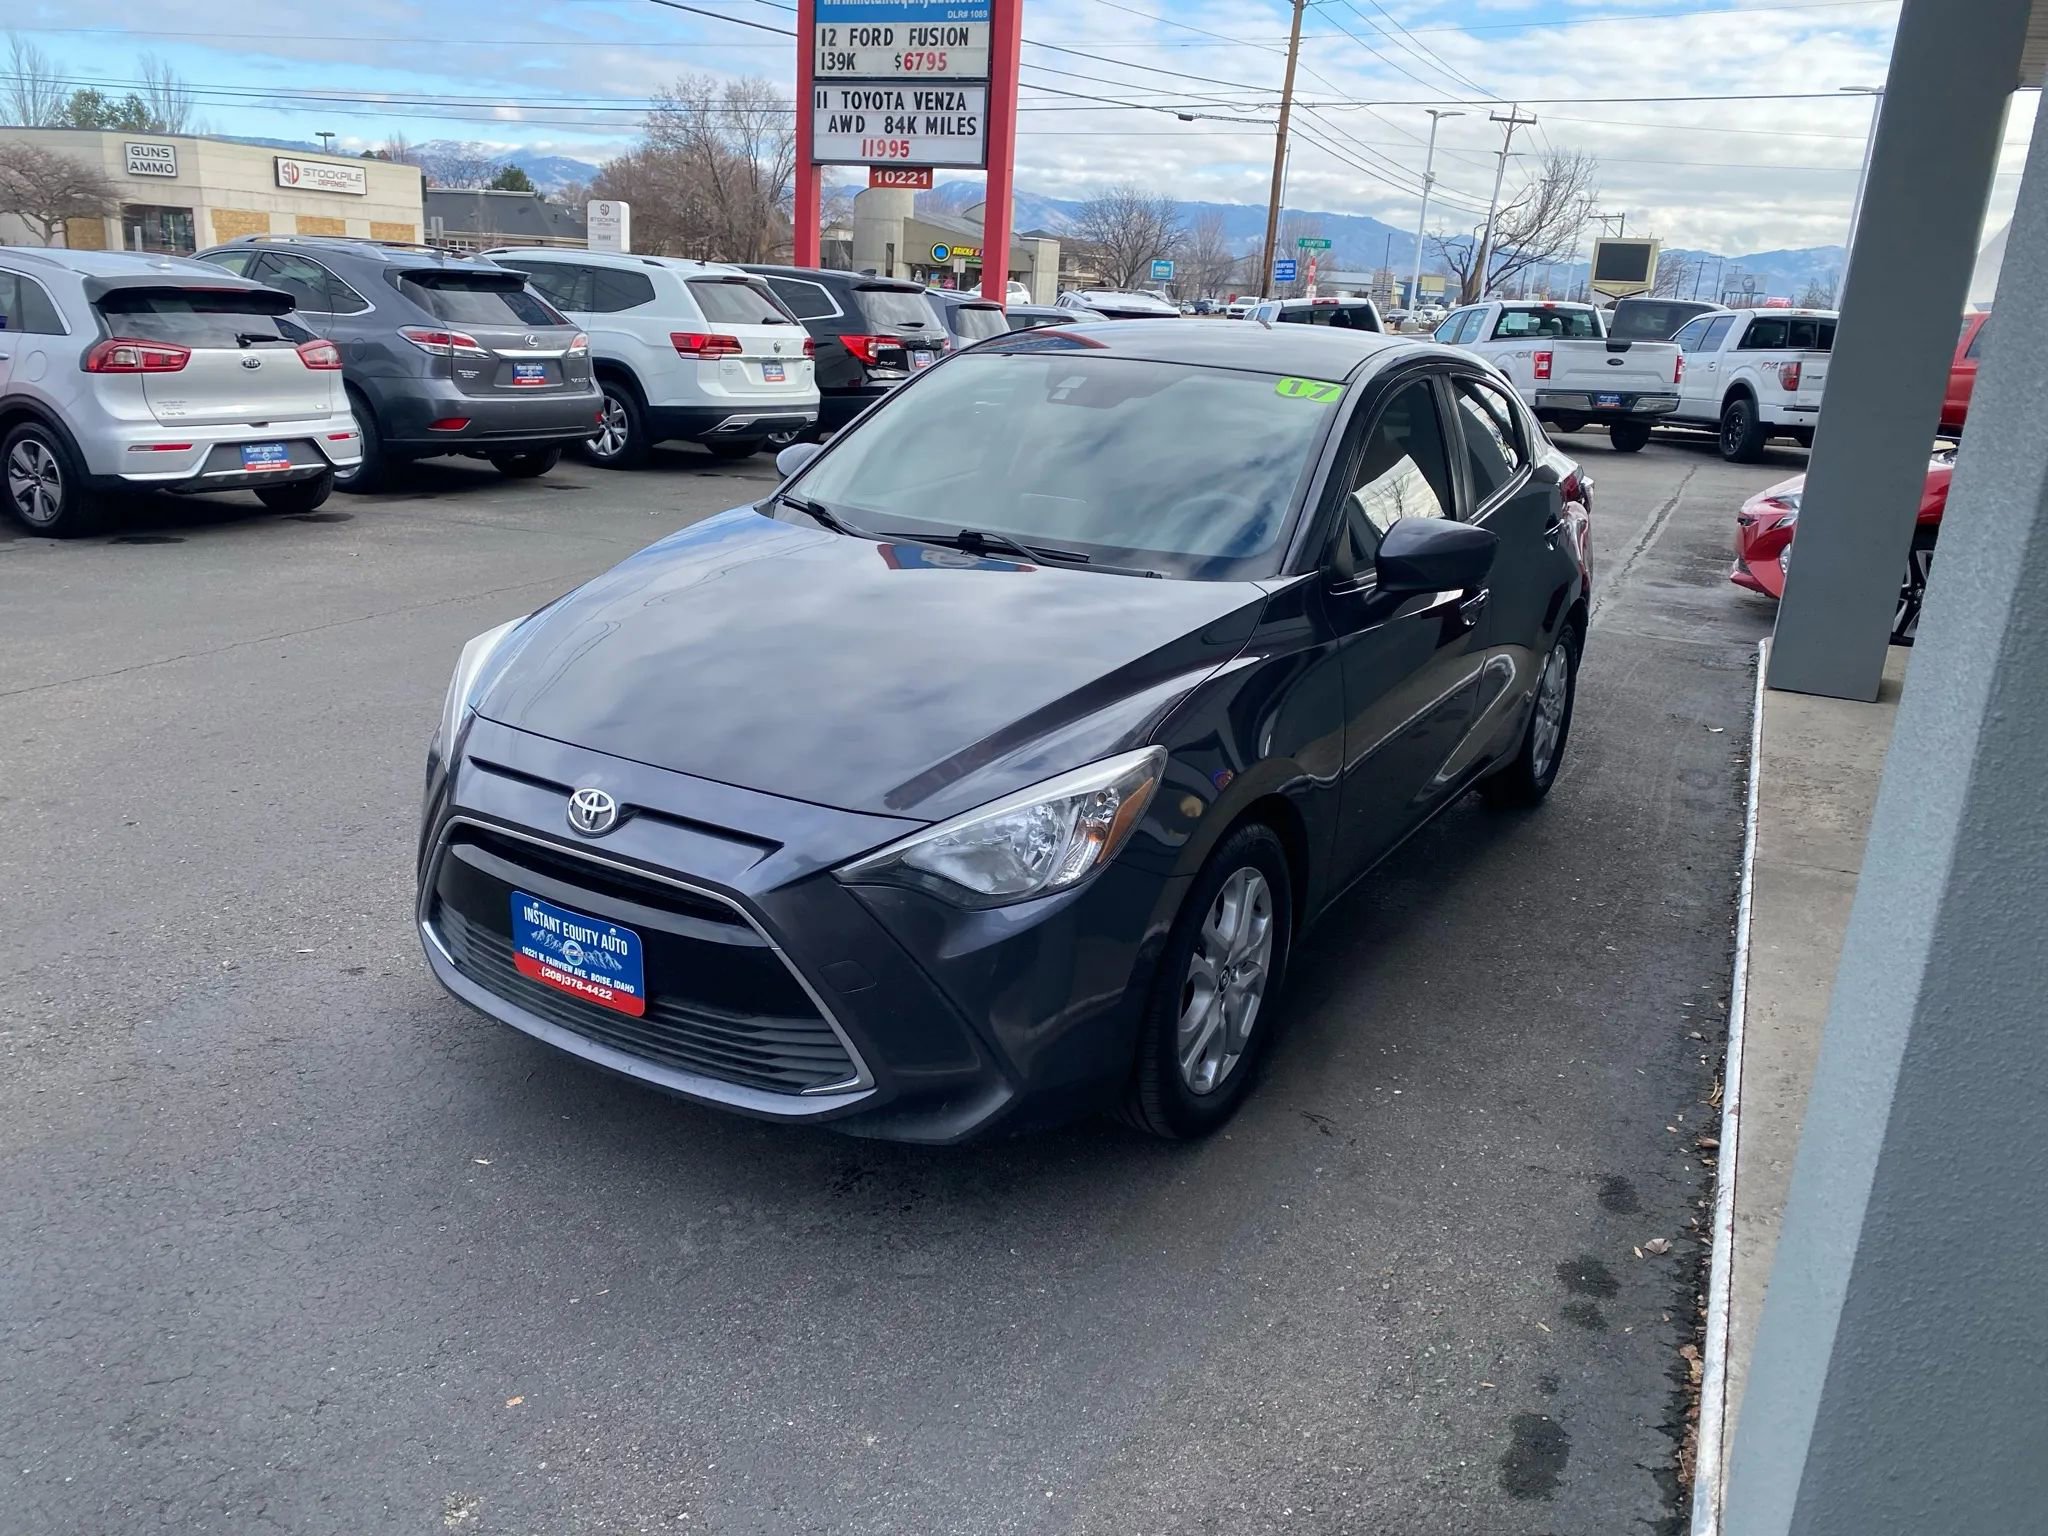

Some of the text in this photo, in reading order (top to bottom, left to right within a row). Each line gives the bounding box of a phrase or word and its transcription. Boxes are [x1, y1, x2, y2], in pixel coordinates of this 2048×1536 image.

[821, 27, 969, 47] 12 FORD FUSION
[821, 52, 948, 71] 139K $6795
[816, 91, 967, 111] 11 TOYOTA VENZA
[828, 115, 977, 135] AWD 84K MILES
[130, 146, 170, 158] GUNS
[861, 138, 910, 158] 11995
[130, 161, 174, 174] AMMO
[302, 167, 363, 182] STOCKPILE
[874, 170, 928, 185] 10221
[1287, 380, 1338, 399] 17
[523, 905, 628, 955] INSTANT EQUITY AUTO
[541, 966, 613, 1000] (208)378-4422
[546, 955, 573, 974] FAIRVIEW
[613, 979, 635, 994] IDAHO
